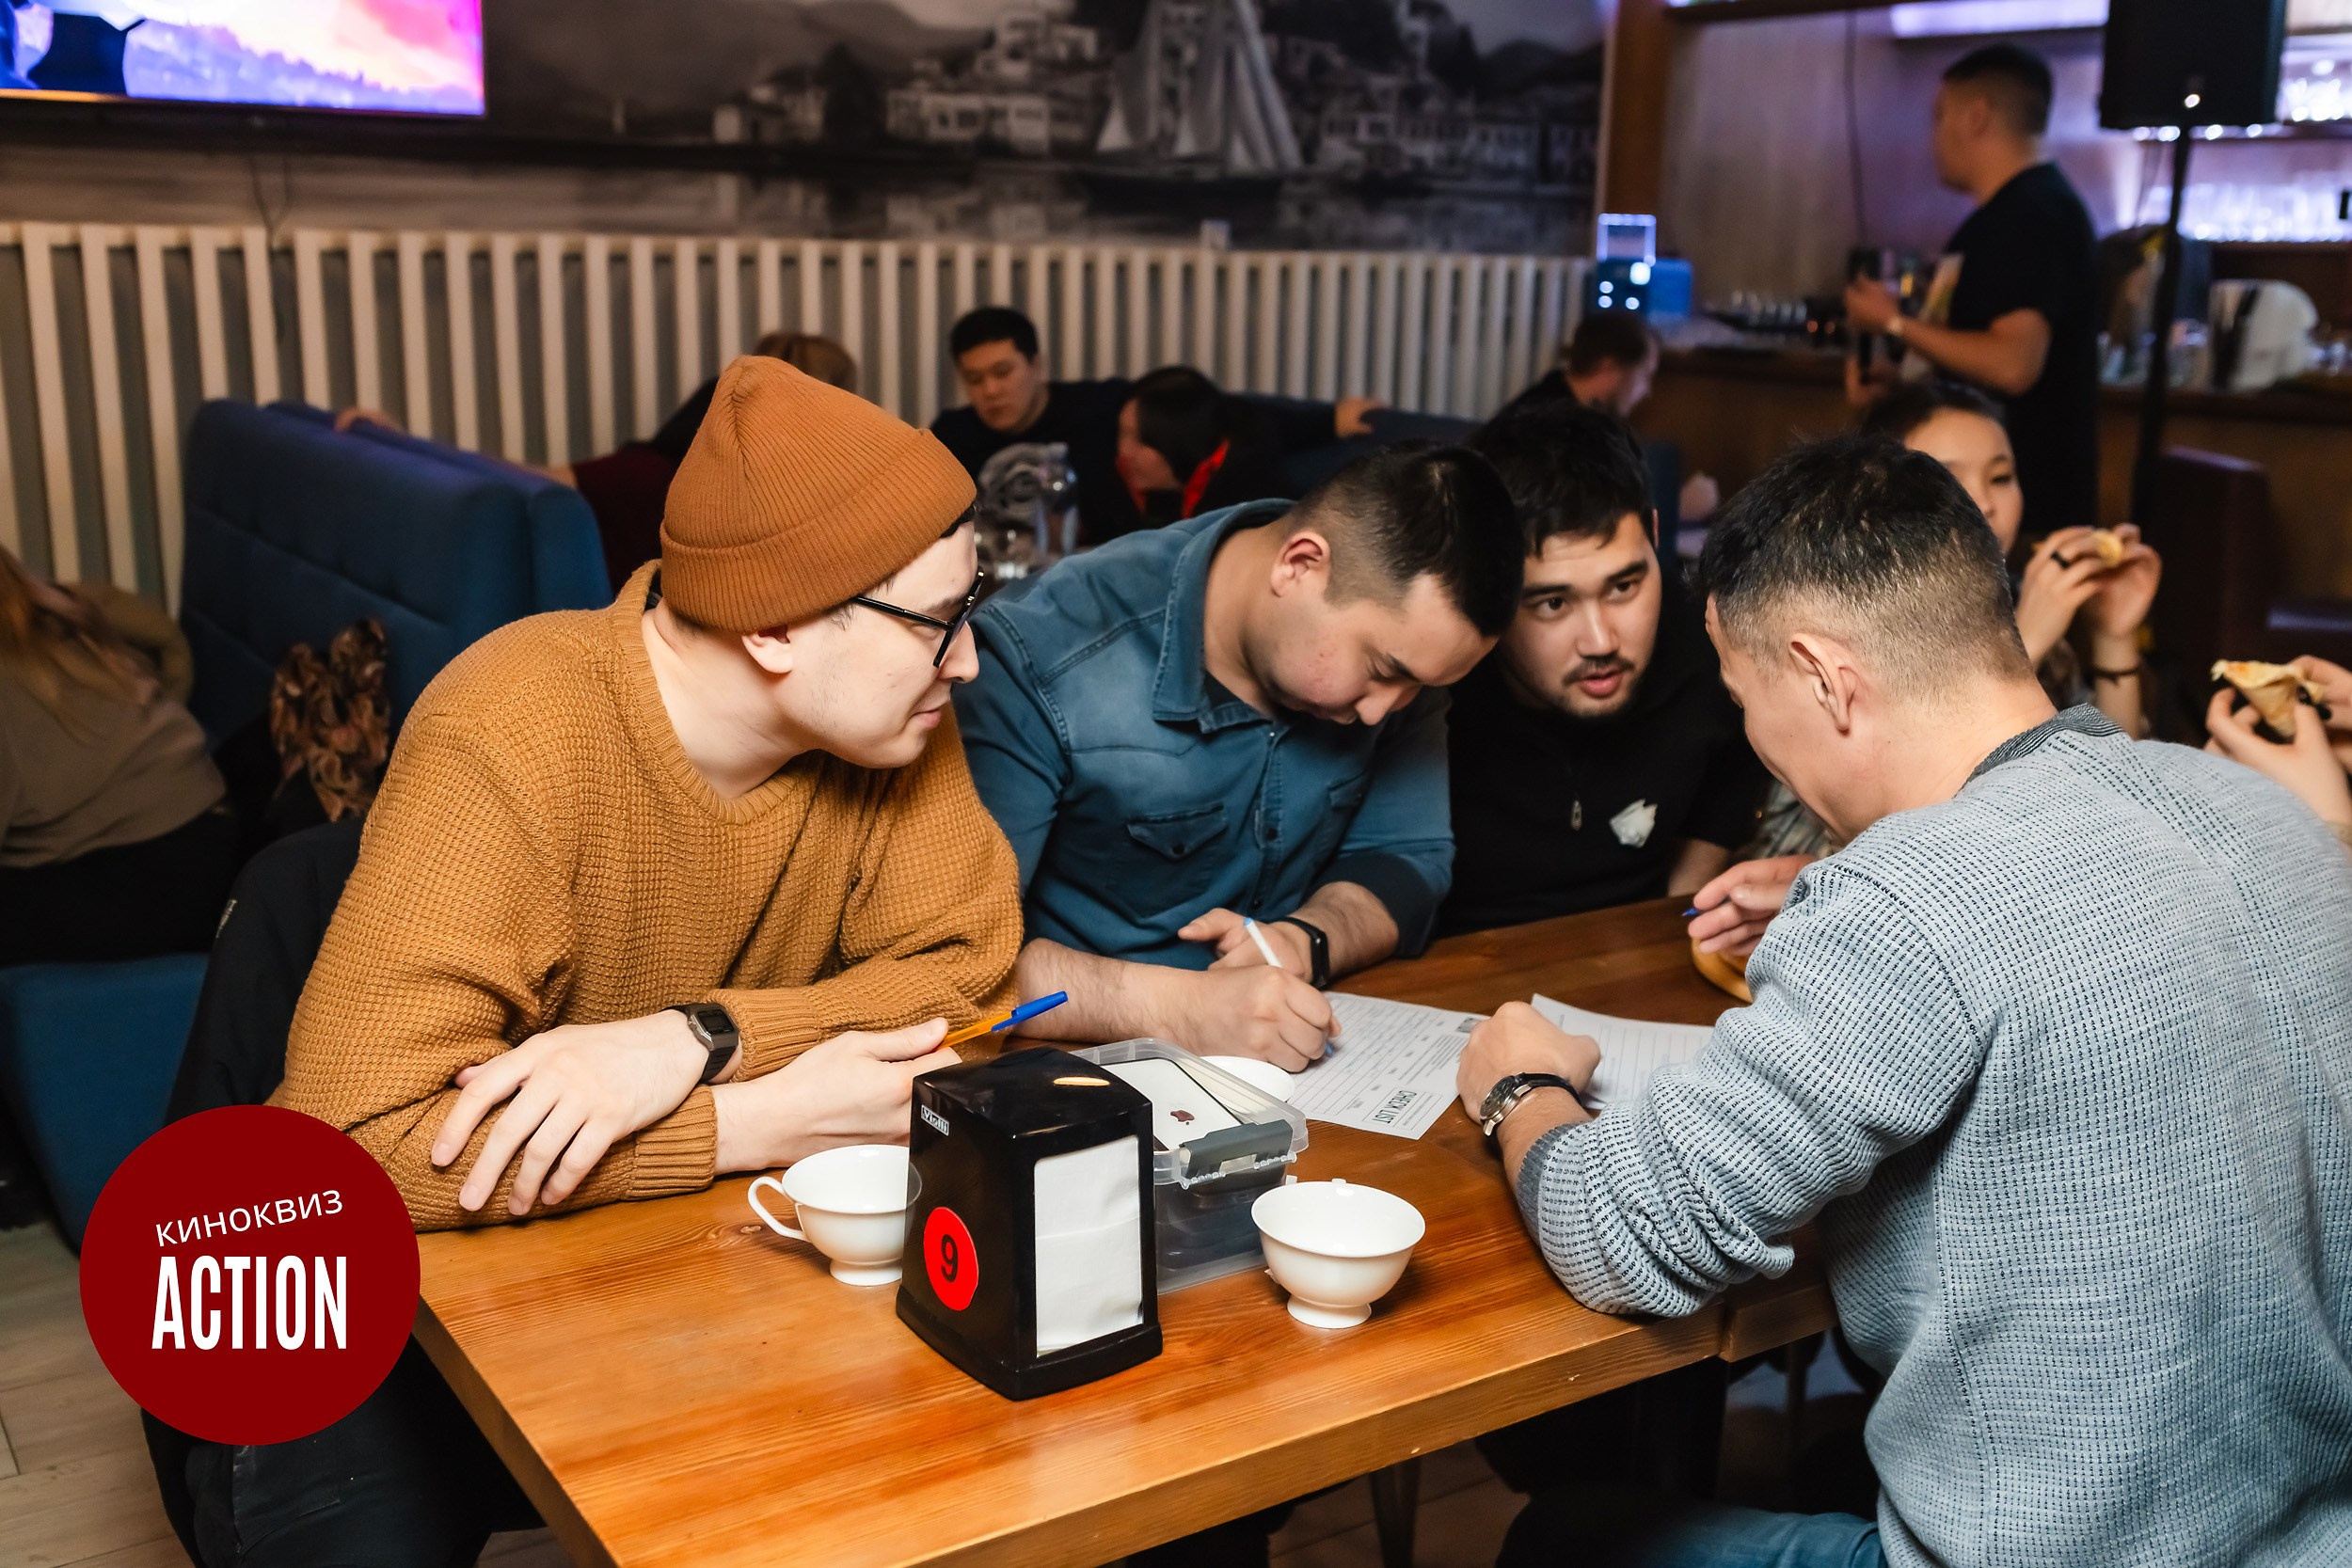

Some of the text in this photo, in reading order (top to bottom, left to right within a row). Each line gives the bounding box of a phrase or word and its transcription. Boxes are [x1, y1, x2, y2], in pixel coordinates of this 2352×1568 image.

[1372, 1090, 1417, 1124] CHECK LIST
[941, 1233, 959, 1283] 9
